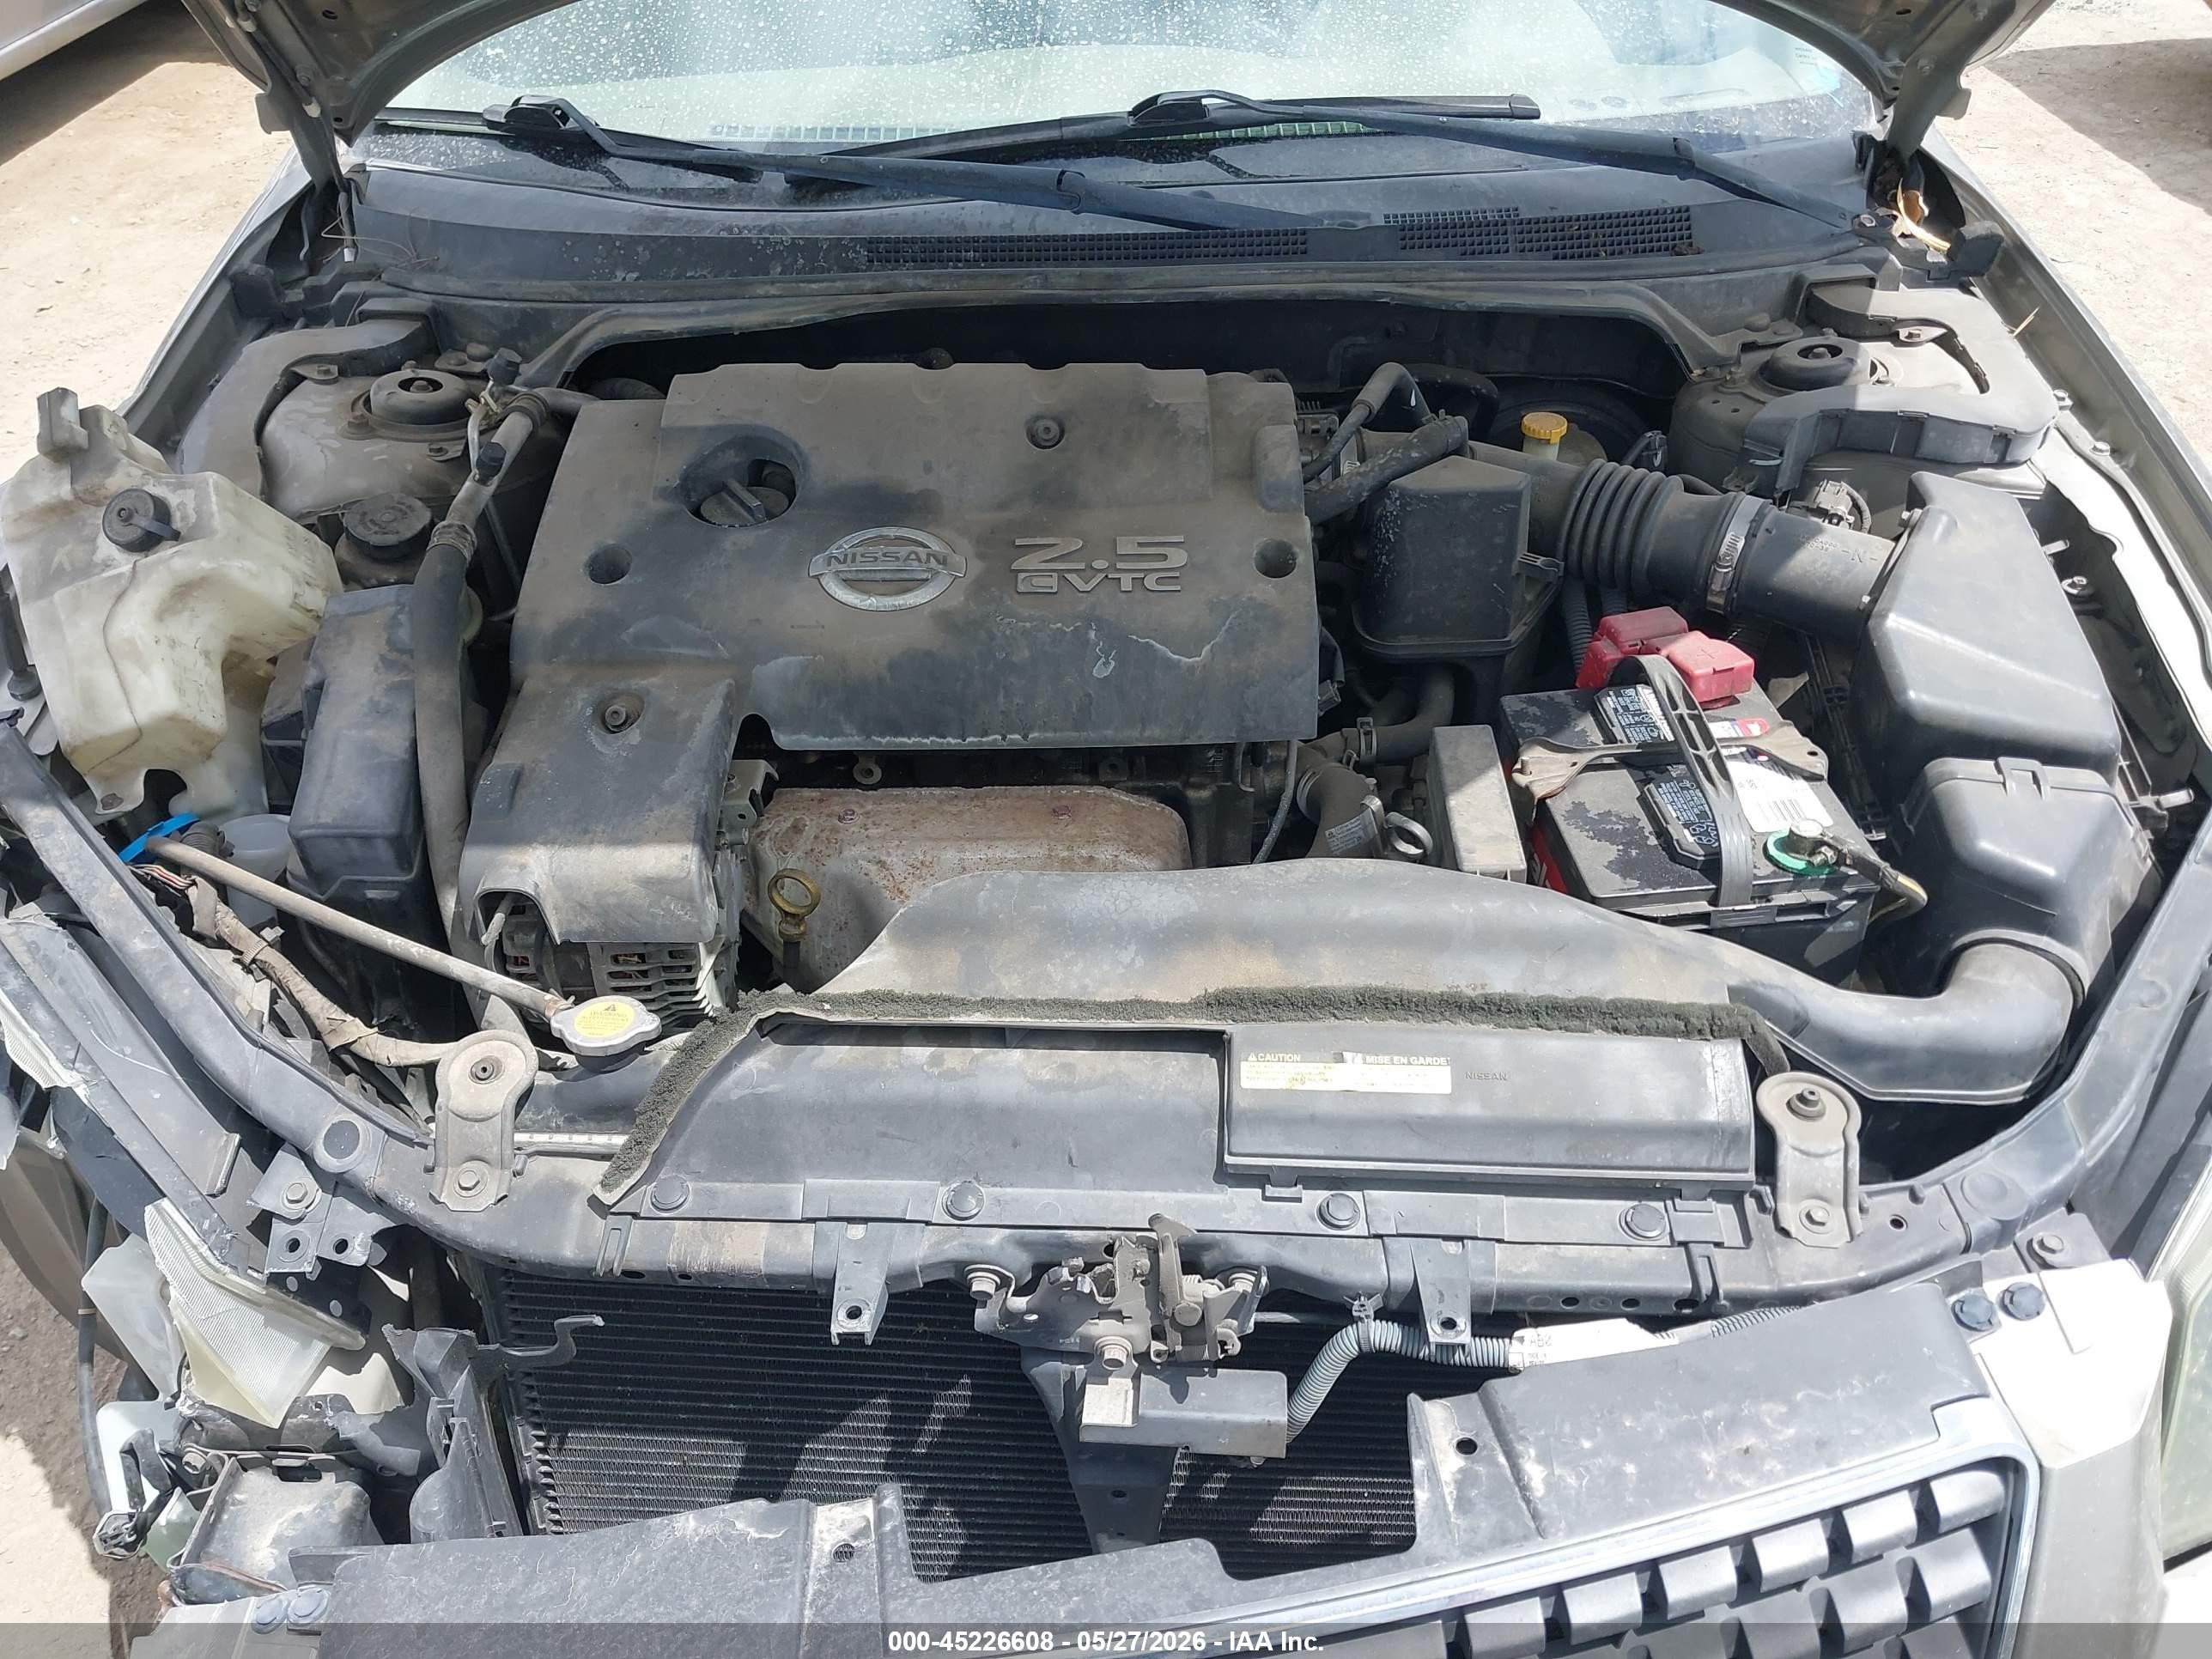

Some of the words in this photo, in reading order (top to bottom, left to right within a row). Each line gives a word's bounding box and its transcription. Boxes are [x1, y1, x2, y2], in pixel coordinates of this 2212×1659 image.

[1011, 535, 1188, 570] 2.5
[826, 550, 949, 567] NISSAN
[1257, 1053, 1302, 1062] CAUTION
[1365, 1055, 1390, 1065] MISE
[1393, 1055, 1408, 1065] EN
[1409, 1056, 1449, 1066] GARDE
[1465, 1071, 1509, 1081] NISSAN
